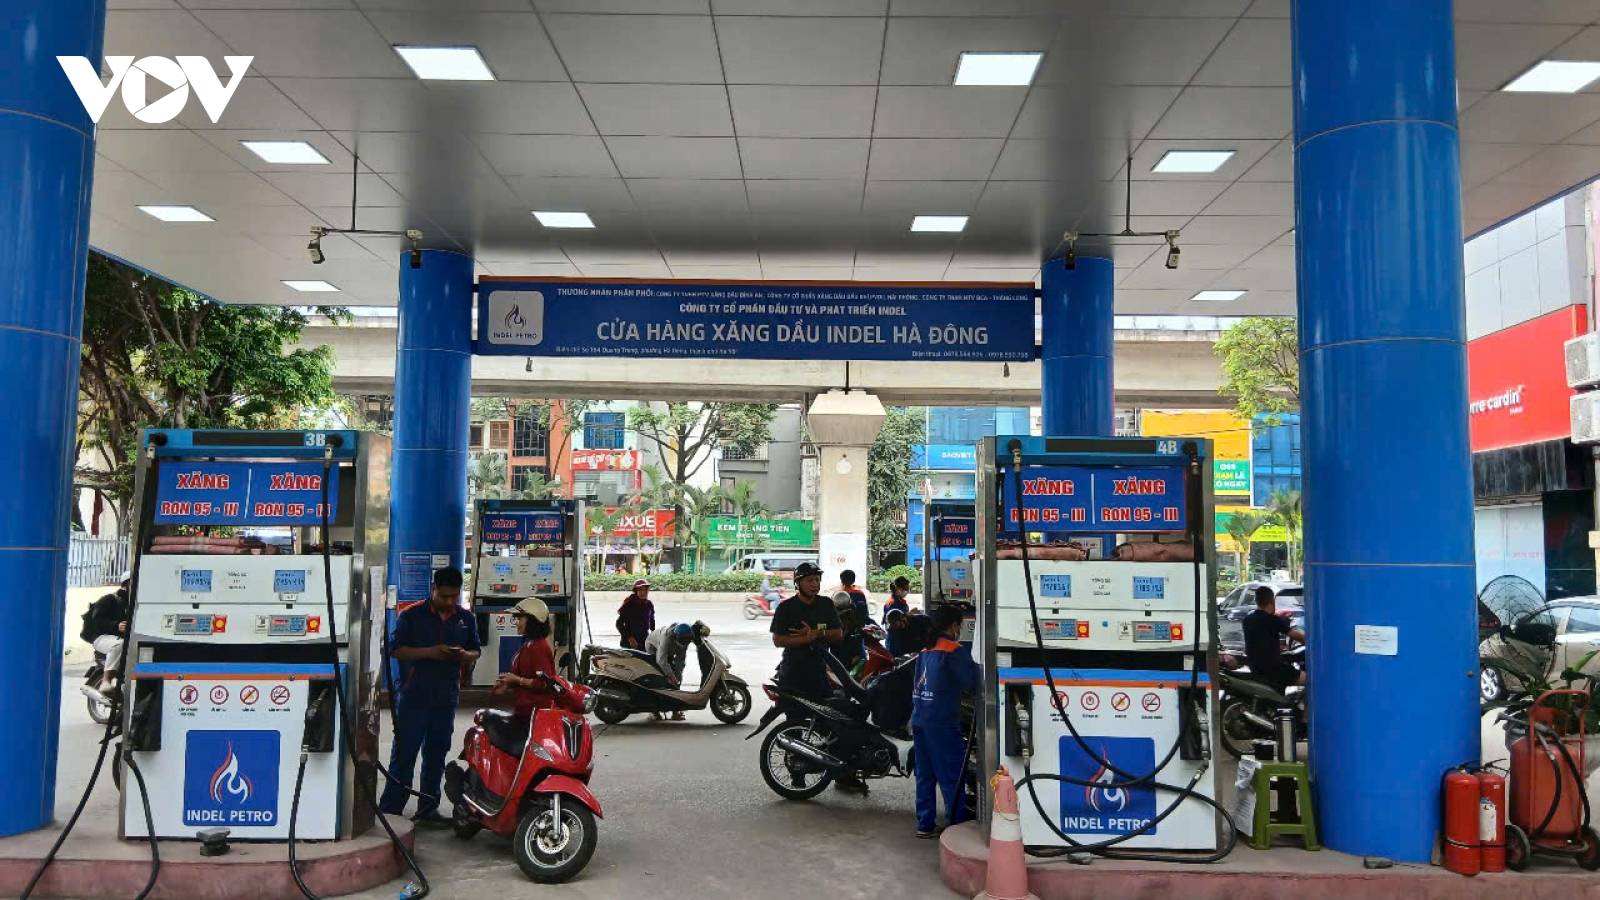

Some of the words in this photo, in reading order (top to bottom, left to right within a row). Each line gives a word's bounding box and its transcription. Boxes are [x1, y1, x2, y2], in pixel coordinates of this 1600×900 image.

[590, 287, 612, 296] NHÂN
[613, 287, 635, 297] PHÂN
[679, 302, 707, 313] CÔNG
[708, 304, 721, 313] TY
[723, 301, 737, 313] CỔ
[738, 302, 766, 314] PHẦN
[790, 304, 804, 314] TƯ
[804, 303, 818, 315] VÀ
[847, 302, 876, 315] TRIỂN
[878, 305, 907, 316] INDEL
[516, 332, 538, 341] PETRO
[597, 318, 640, 341] CỬA
[647, 320, 705, 341] HÀNG
[712, 320, 770, 342] XĂNG
[777, 319, 820, 343] DẦU
[827, 325, 886, 343] INDEL
[893, 322, 922, 344] HÀ
[928, 323, 988, 345] ĐÔNG
[1487, 389, 1520, 410] cardin
[305, 433, 326, 446] 3B
[1158, 441, 1177, 454] 4B
[176, 471, 230, 490] XĂNG
[270, 472, 322, 491] XĂNG
[1022, 477, 1075, 496] XĂNG
[1113, 476, 1166, 496] XĂNG
[160, 501, 191, 516] RON
[193, 502, 212, 516] 95
[223, 503, 239, 517] III
[255, 503, 284, 517] RON
[287, 504, 305, 517] 95
[316, 505, 331, 517] II
[1042, 508, 1059, 522] 95
[1071, 508, 1086, 522] III
[1101, 508, 1130, 523] RON
[1133, 508, 1152, 523] 95
[1163, 508, 1179, 523] III
[614, 515, 656, 528] IXUE
[187, 809, 225, 821] INDEL
[230, 810, 272, 822] PETRO
[1064, 817, 1104, 830] INDEL
